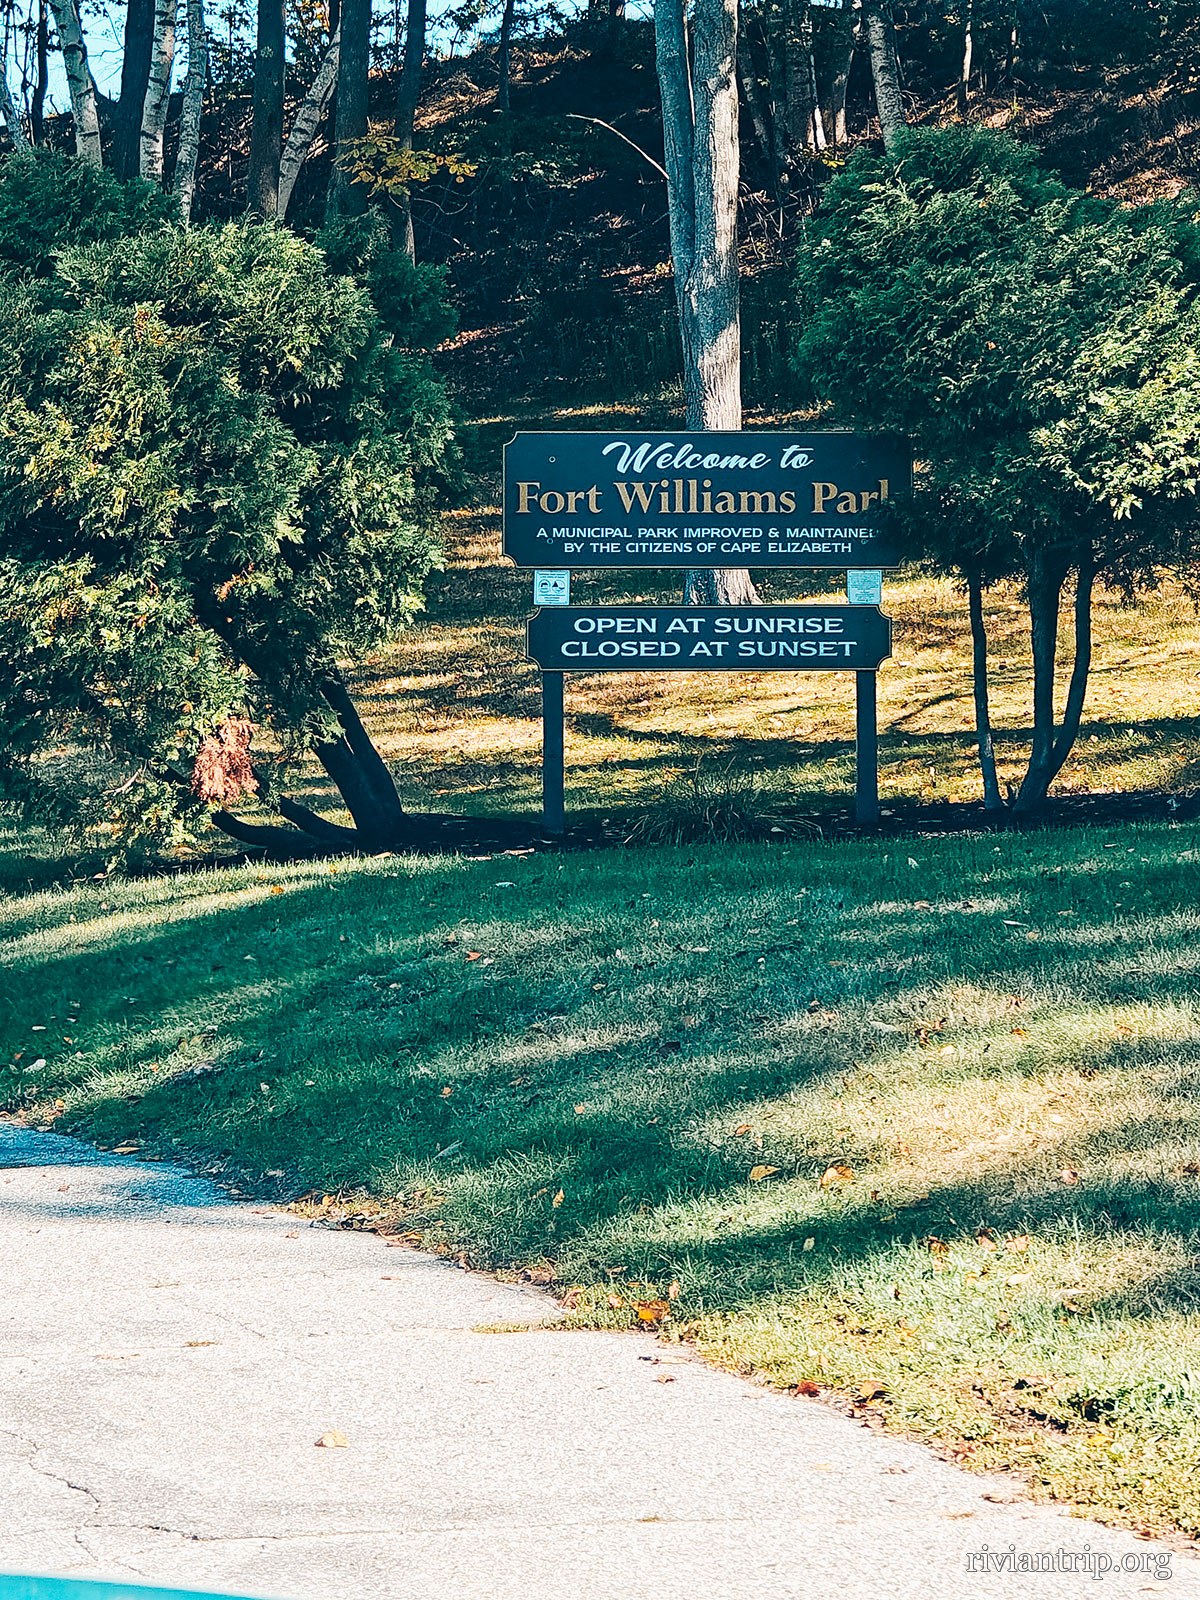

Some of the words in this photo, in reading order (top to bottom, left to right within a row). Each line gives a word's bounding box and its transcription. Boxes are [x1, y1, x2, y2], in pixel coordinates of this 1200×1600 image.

[601, 441, 771, 474] Welcome
[780, 444, 814, 469] to
[515, 481, 603, 514] Fort
[613, 479, 797, 514] Williams
[536, 527, 548, 538] A
[552, 527, 632, 538] MUNICIPAL
[638, 527, 678, 538] PARK
[683, 527, 763, 538] IMPROVED
[768, 527, 780, 538] &
[564, 542, 586, 553] BY
[590, 542, 621, 553] THE
[625, 542, 693, 553] CITIZENS
[696, 542, 717, 553] OF
[720, 542, 761, 553] CAPE
[768, 542, 852, 553] ELIZABETH
[573, 617, 657, 634] OPEN
[665, 617, 706, 634] AT
[714, 617, 844, 634] SUNRISE
[560, 641, 681, 657] CLOSED
[689, 641, 729, 657] AT
[738, 641, 858, 657] SUNSET
